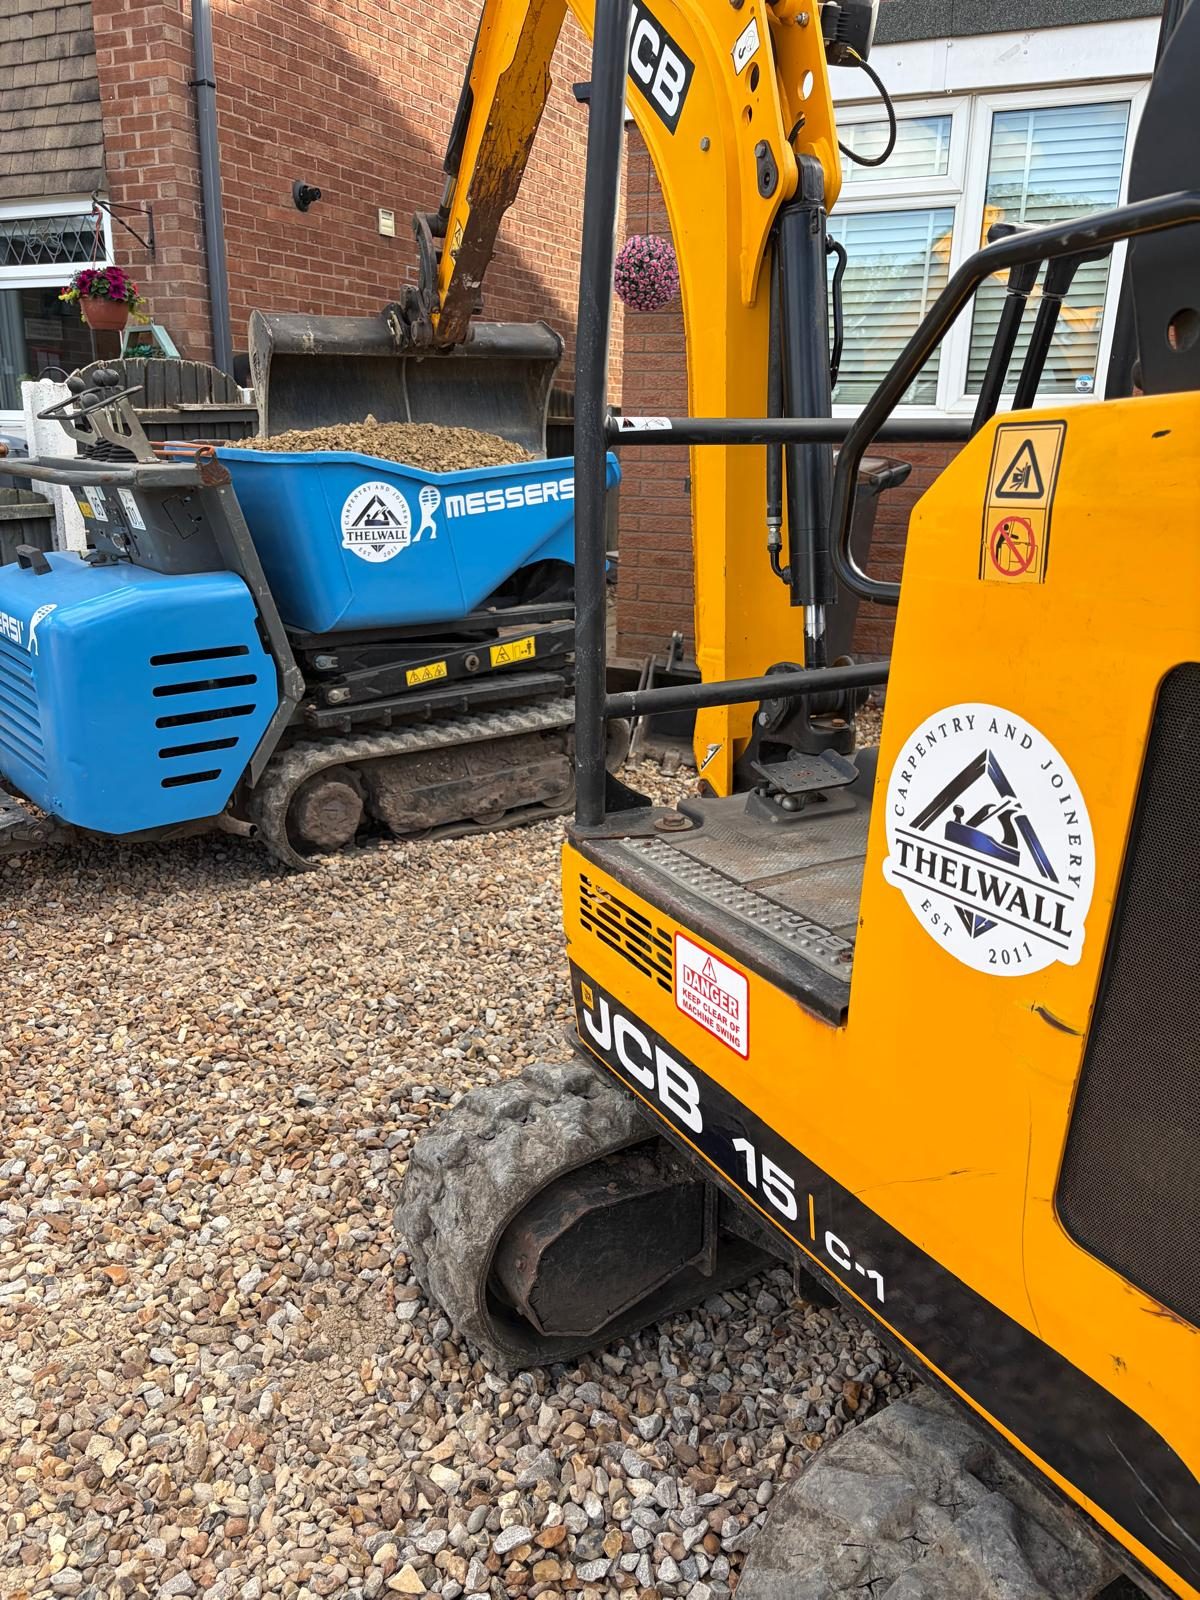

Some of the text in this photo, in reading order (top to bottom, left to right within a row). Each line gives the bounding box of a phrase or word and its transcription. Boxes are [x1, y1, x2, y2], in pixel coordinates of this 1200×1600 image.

[344, 484, 409, 526] CARPENTRY AND JOINERY
[346, 529, 408, 541] THELWALL
[358, 545, 398, 558] EST 2011
[894, 714, 1083, 889] CARPENTRY AND JOINERY
[895, 837, 1073, 938] THELWALL
[920, 898, 1034, 966] EST 2011
[682, 987, 741, 1034] KEEP CLEAR OF
[684, 965, 739, 1020] DANGER
[682, 998, 741, 1048] MACHINE SWING
[583, 996, 704, 1134] JCB
[731, 1137, 885, 1304] 15 C-1
